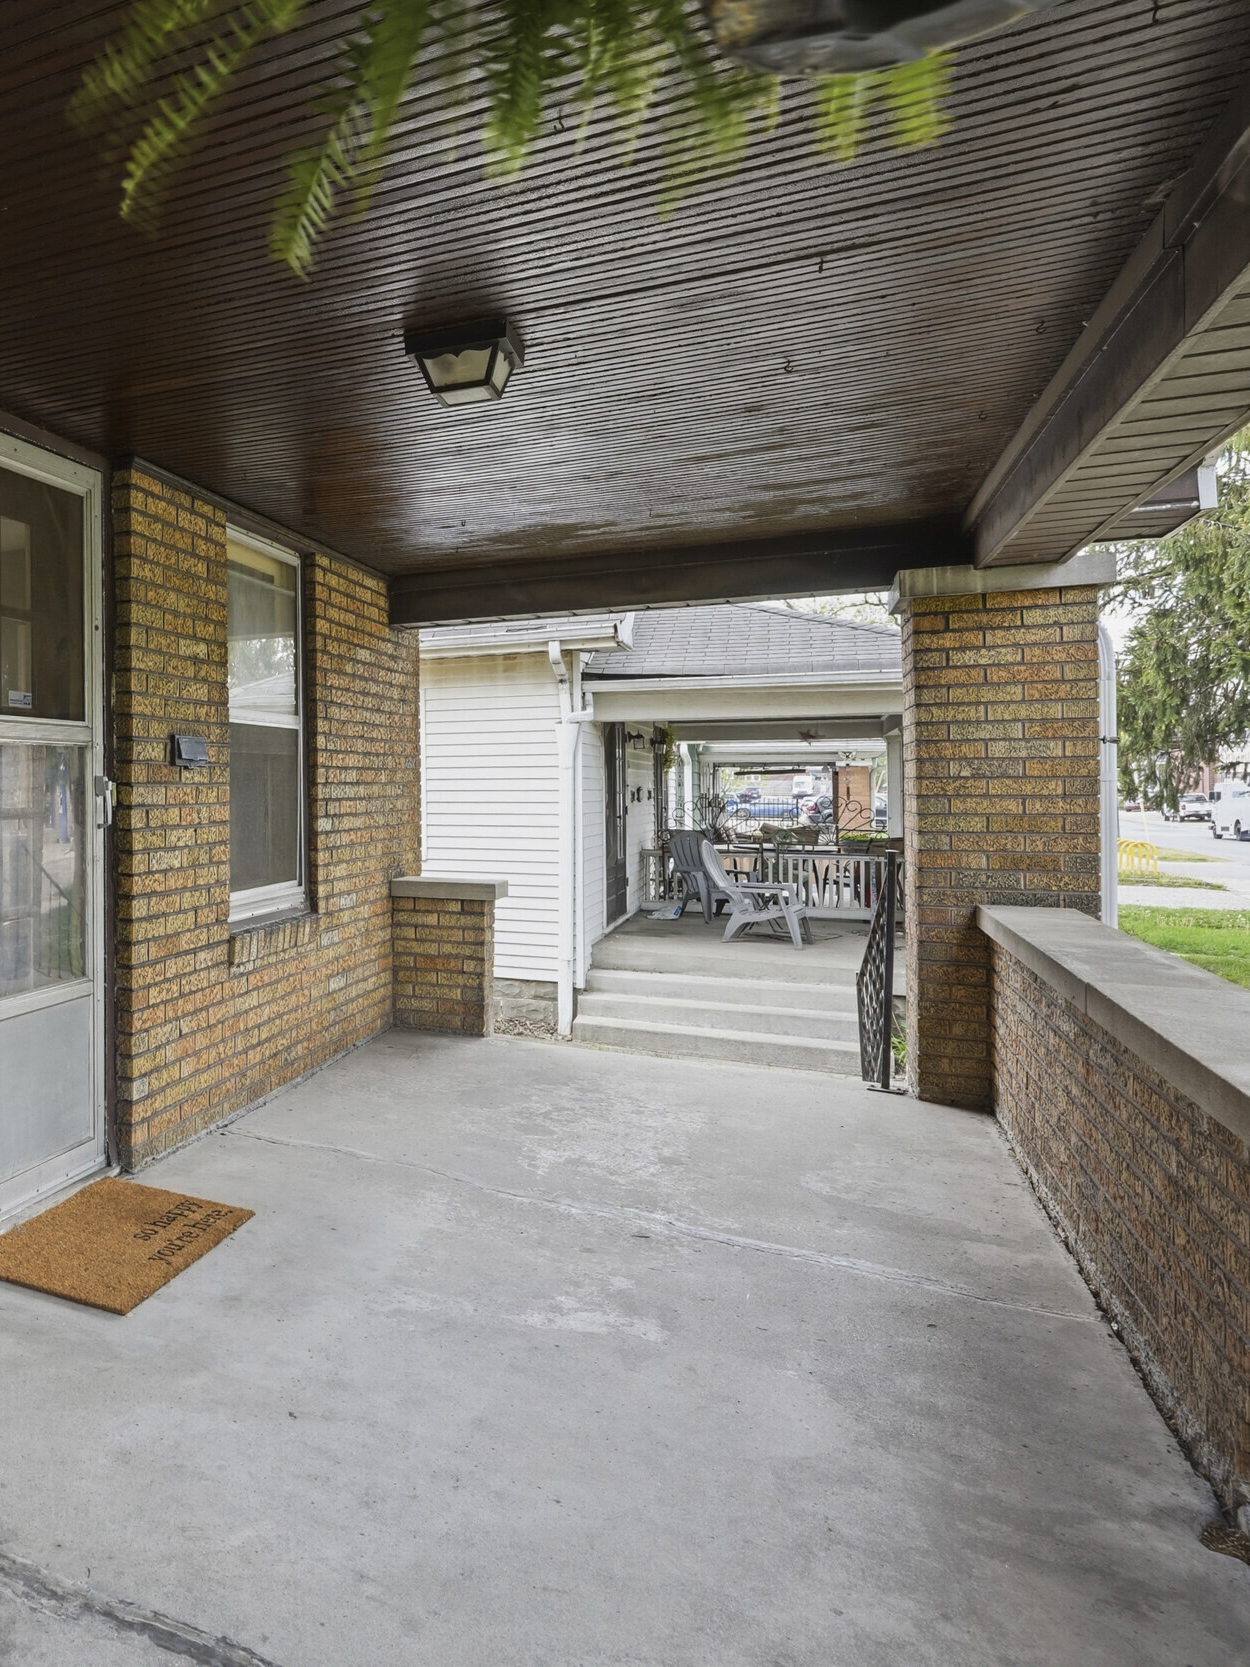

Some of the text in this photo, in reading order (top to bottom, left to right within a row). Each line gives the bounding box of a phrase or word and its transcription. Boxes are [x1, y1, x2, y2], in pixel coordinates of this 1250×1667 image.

[134, 1200, 203, 1241] so happy
[148, 1231, 200, 1265] you're
